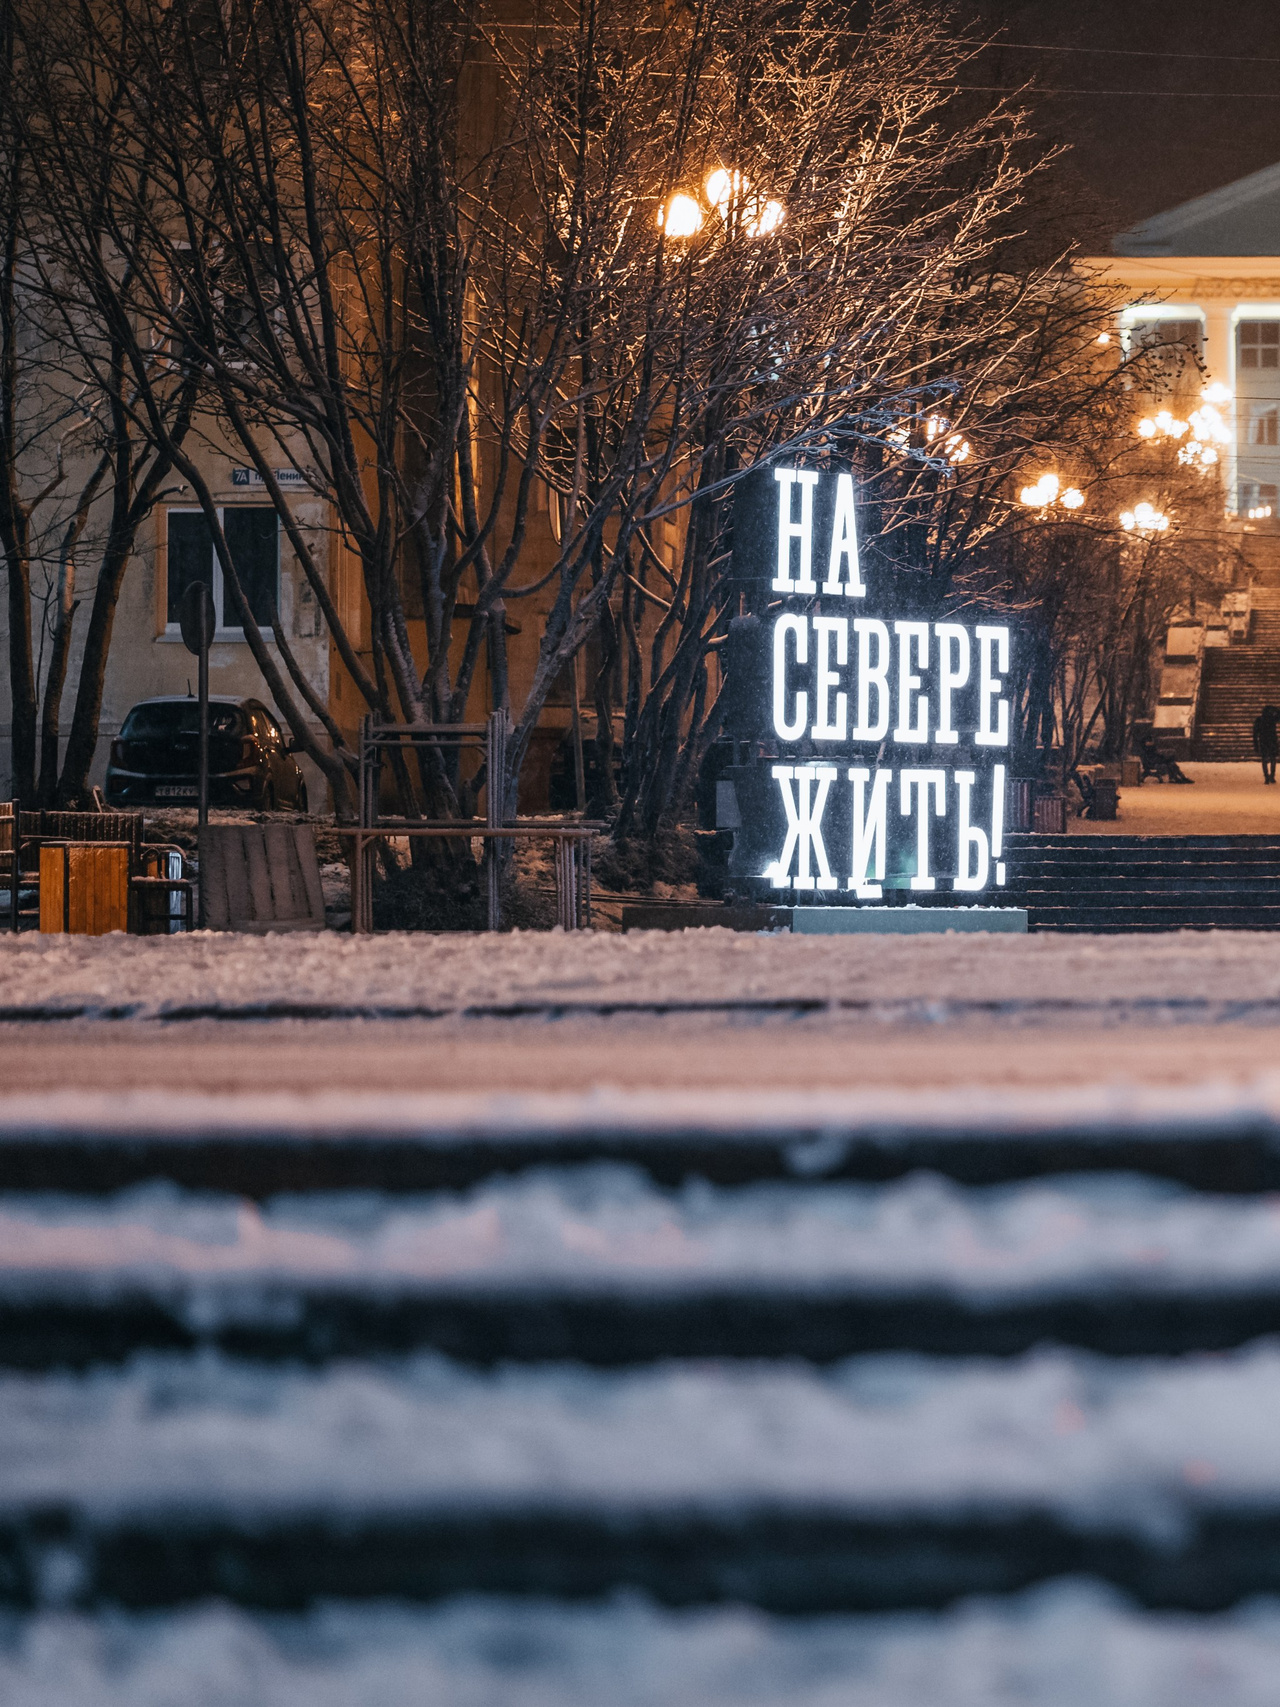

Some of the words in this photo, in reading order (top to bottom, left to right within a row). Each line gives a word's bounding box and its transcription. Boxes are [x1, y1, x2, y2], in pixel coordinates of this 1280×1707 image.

[772, 467, 866, 597] НА
[772, 613, 1010, 746] СЕВЕРЕ
[771, 764, 1006, 894] ЖИТЬ!
